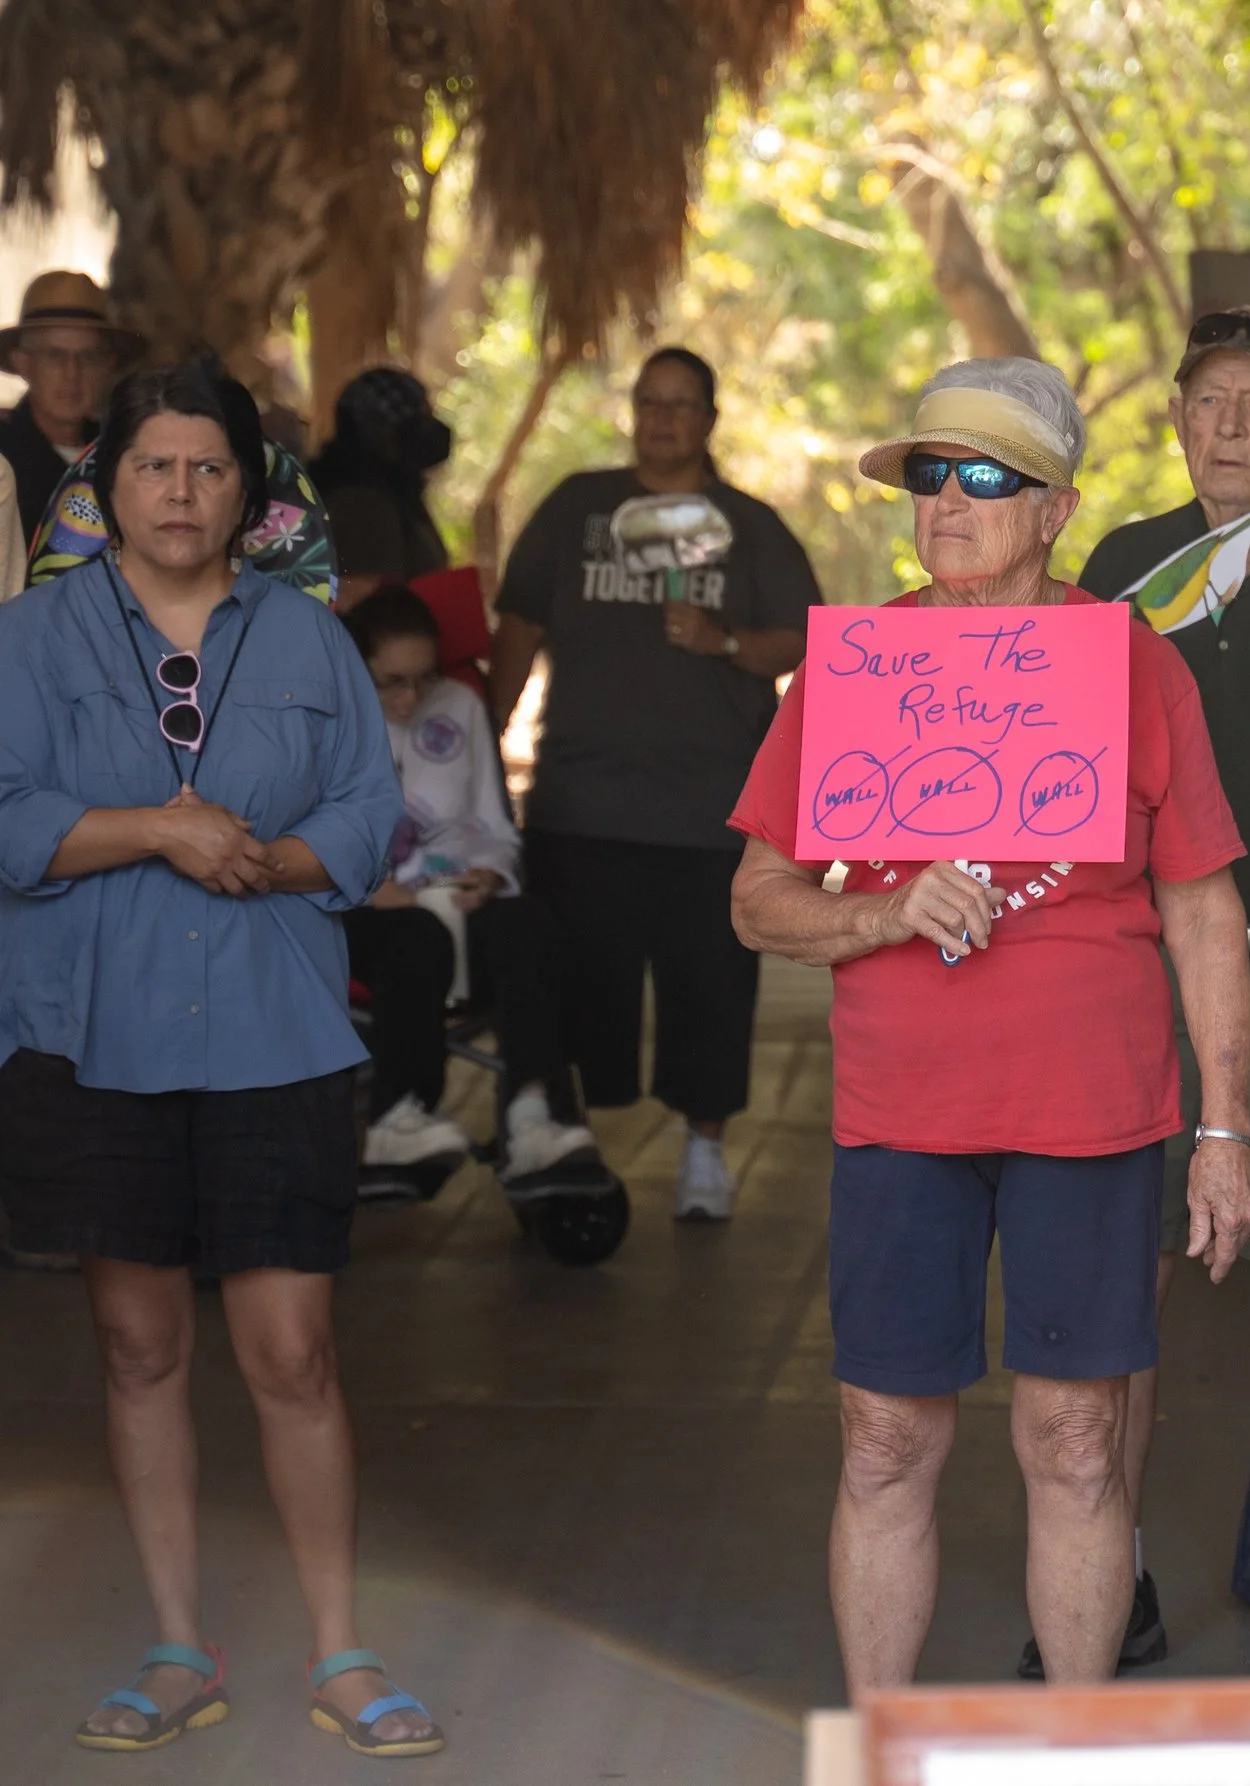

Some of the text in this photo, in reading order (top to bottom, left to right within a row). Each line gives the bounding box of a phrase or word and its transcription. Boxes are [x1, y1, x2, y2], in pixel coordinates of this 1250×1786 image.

[581, 560, 725, 610] TOGETER
[827, 619, 1051, 676] Save The
[899, 683, 1058, 744] Refuge
[825, 779, 1084, 809] WALL WALL WALL
